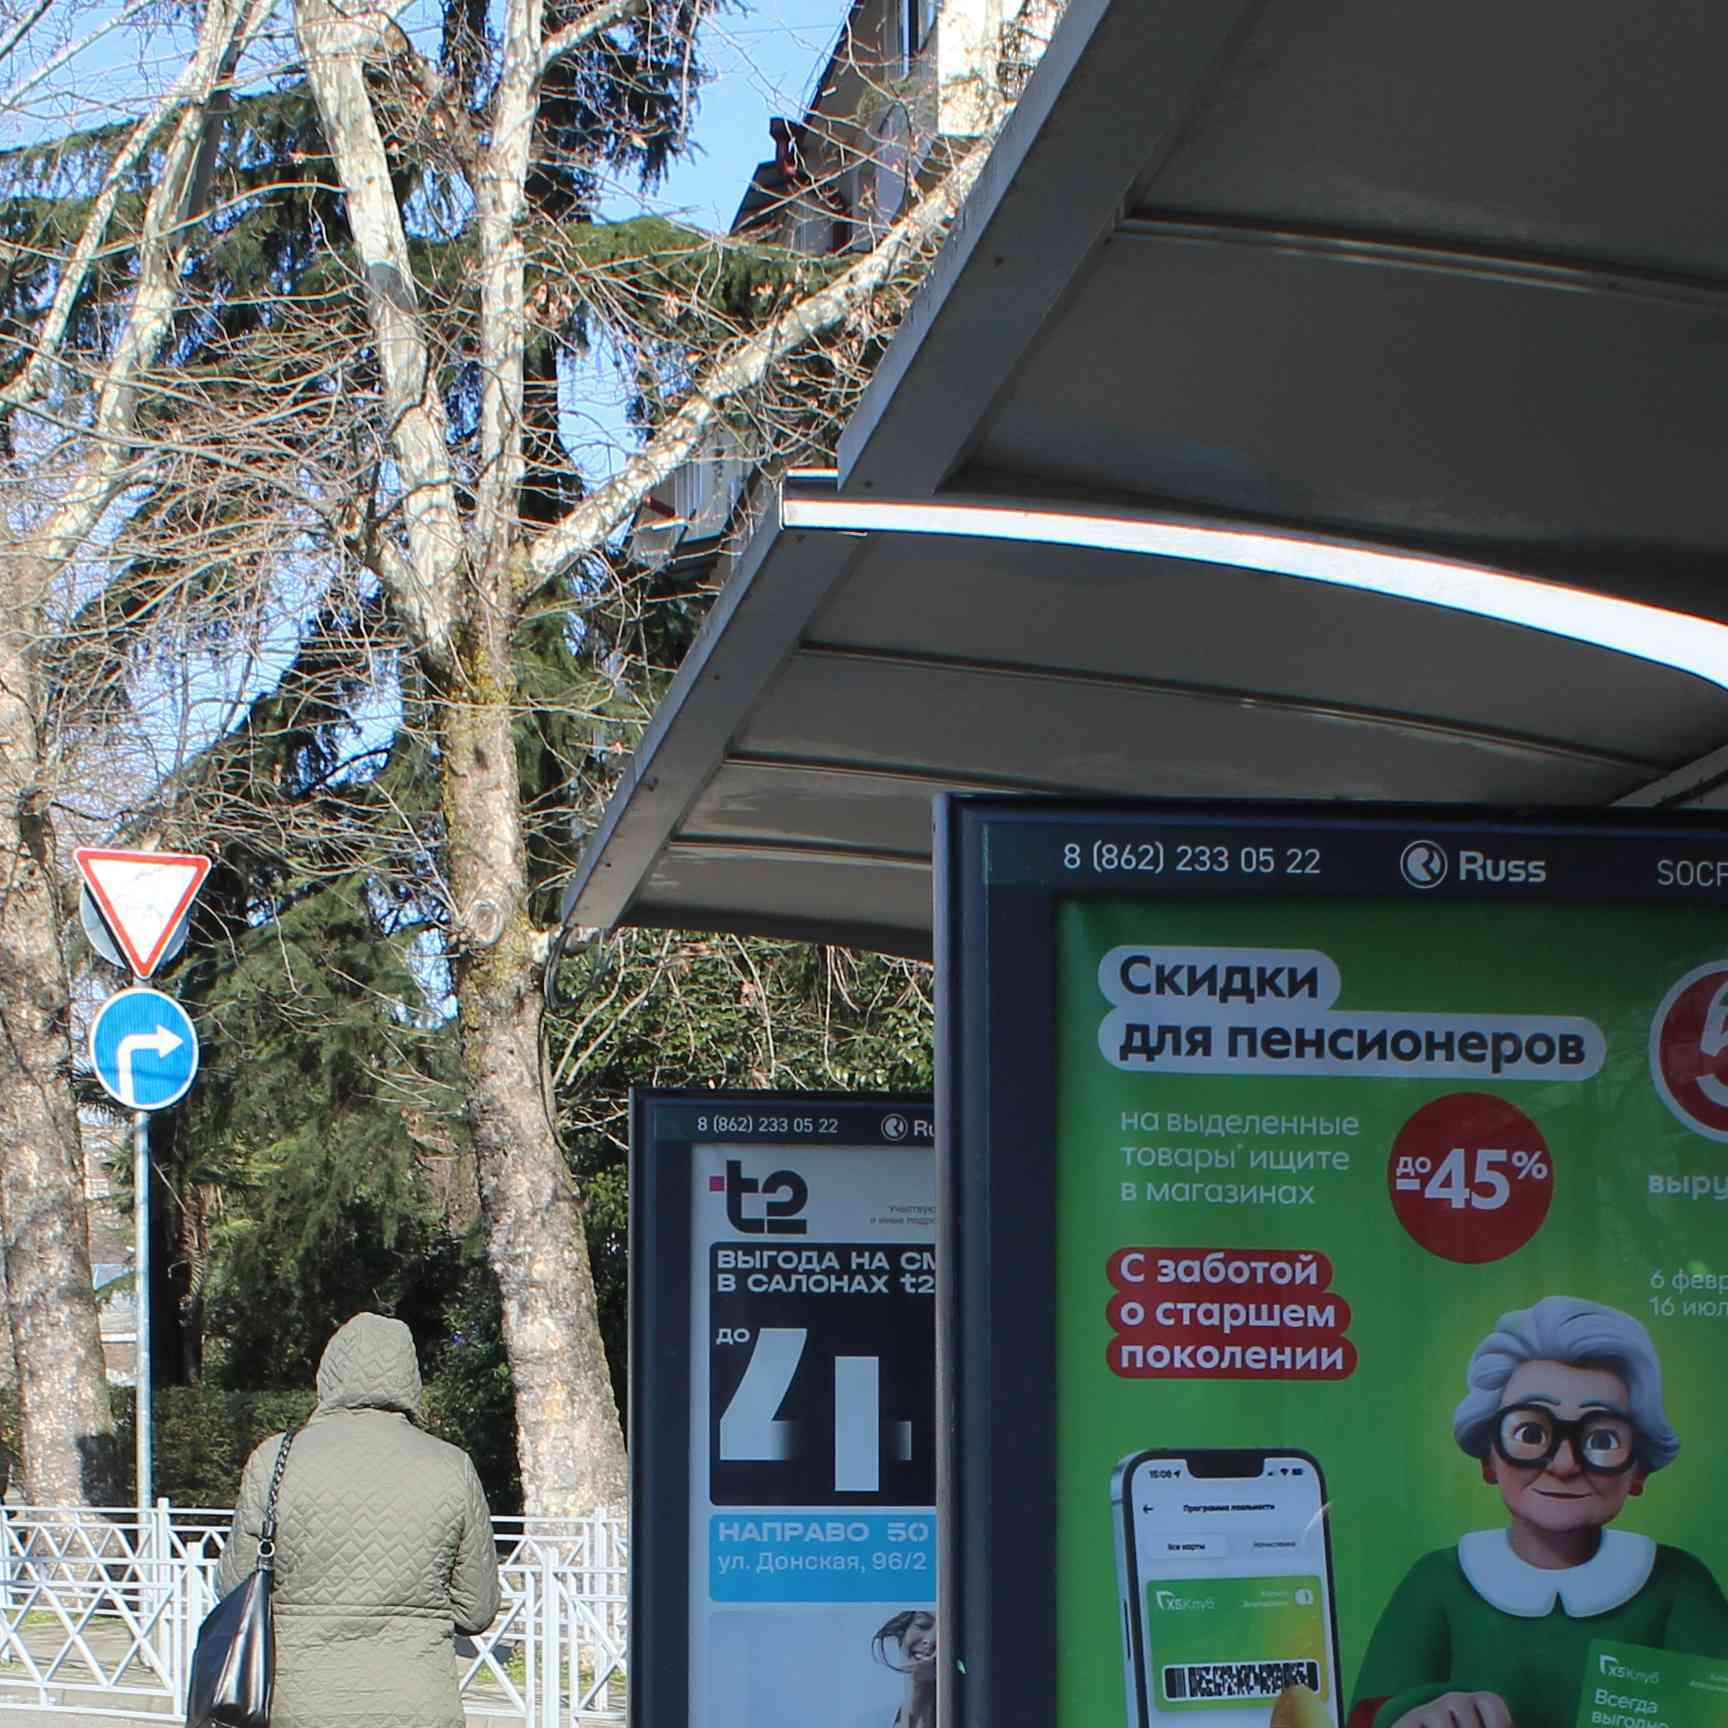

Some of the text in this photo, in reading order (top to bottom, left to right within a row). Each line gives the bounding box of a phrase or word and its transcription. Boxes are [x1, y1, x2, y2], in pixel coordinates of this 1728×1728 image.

[1063, 844, 1080, 871] 8
[1092, 841, 1165, 874] (862)
[1176, 844, 1229, 874] 233
[1242, 845, 1277, 874] 05
[1287, 846, 1322, 875] 22
[1459, 849, 1547, 884] Russ
[1119, 954, 1319, 1004] Скидки
[1119, 1021, 1586, 1075] для пенсионеров
[697, 1118, 706, 1131] 8
[713, 1117, 753, 1134] (862)
[759, 1118, 789, 1133] 233
[794, 1119, 814, 1133] 05
[819, 1119, 838, 1134] 22
[1120, 1111, 1360, 1141] на выделенные
[1249, 1146, 1350, 1178] ищите
[1396, 1153, 1432, 1185] до
[726, 1160, 809, 1234] t2
[1120, 1180, 1315, 1208] в магазинах
[717, 1251, 841, 1274] ВЫГОДА
[851, 1252, 889, 1270] НА
[1119, 1252, 1318, 1290] С заботой
[717, 1274, 736, 1292] В
[748, 1274, 889, 1294] САЛОНАХ
[1650, 1270, 1664, 1290] 6
[1119, 1302, 1336, 1339] о старшем
[1649, 1296, 1674, 1318] 16
[716, 1328, 750, 1345] до
[1119, 1342, 1344, 1374] поколении
[718, 1522, 929, 1543] НАПРАВО 50
[718, 1552, 927, 1574] ул. Донская, 96/2
[1594, 1688, 1658, 1714] Всегда
